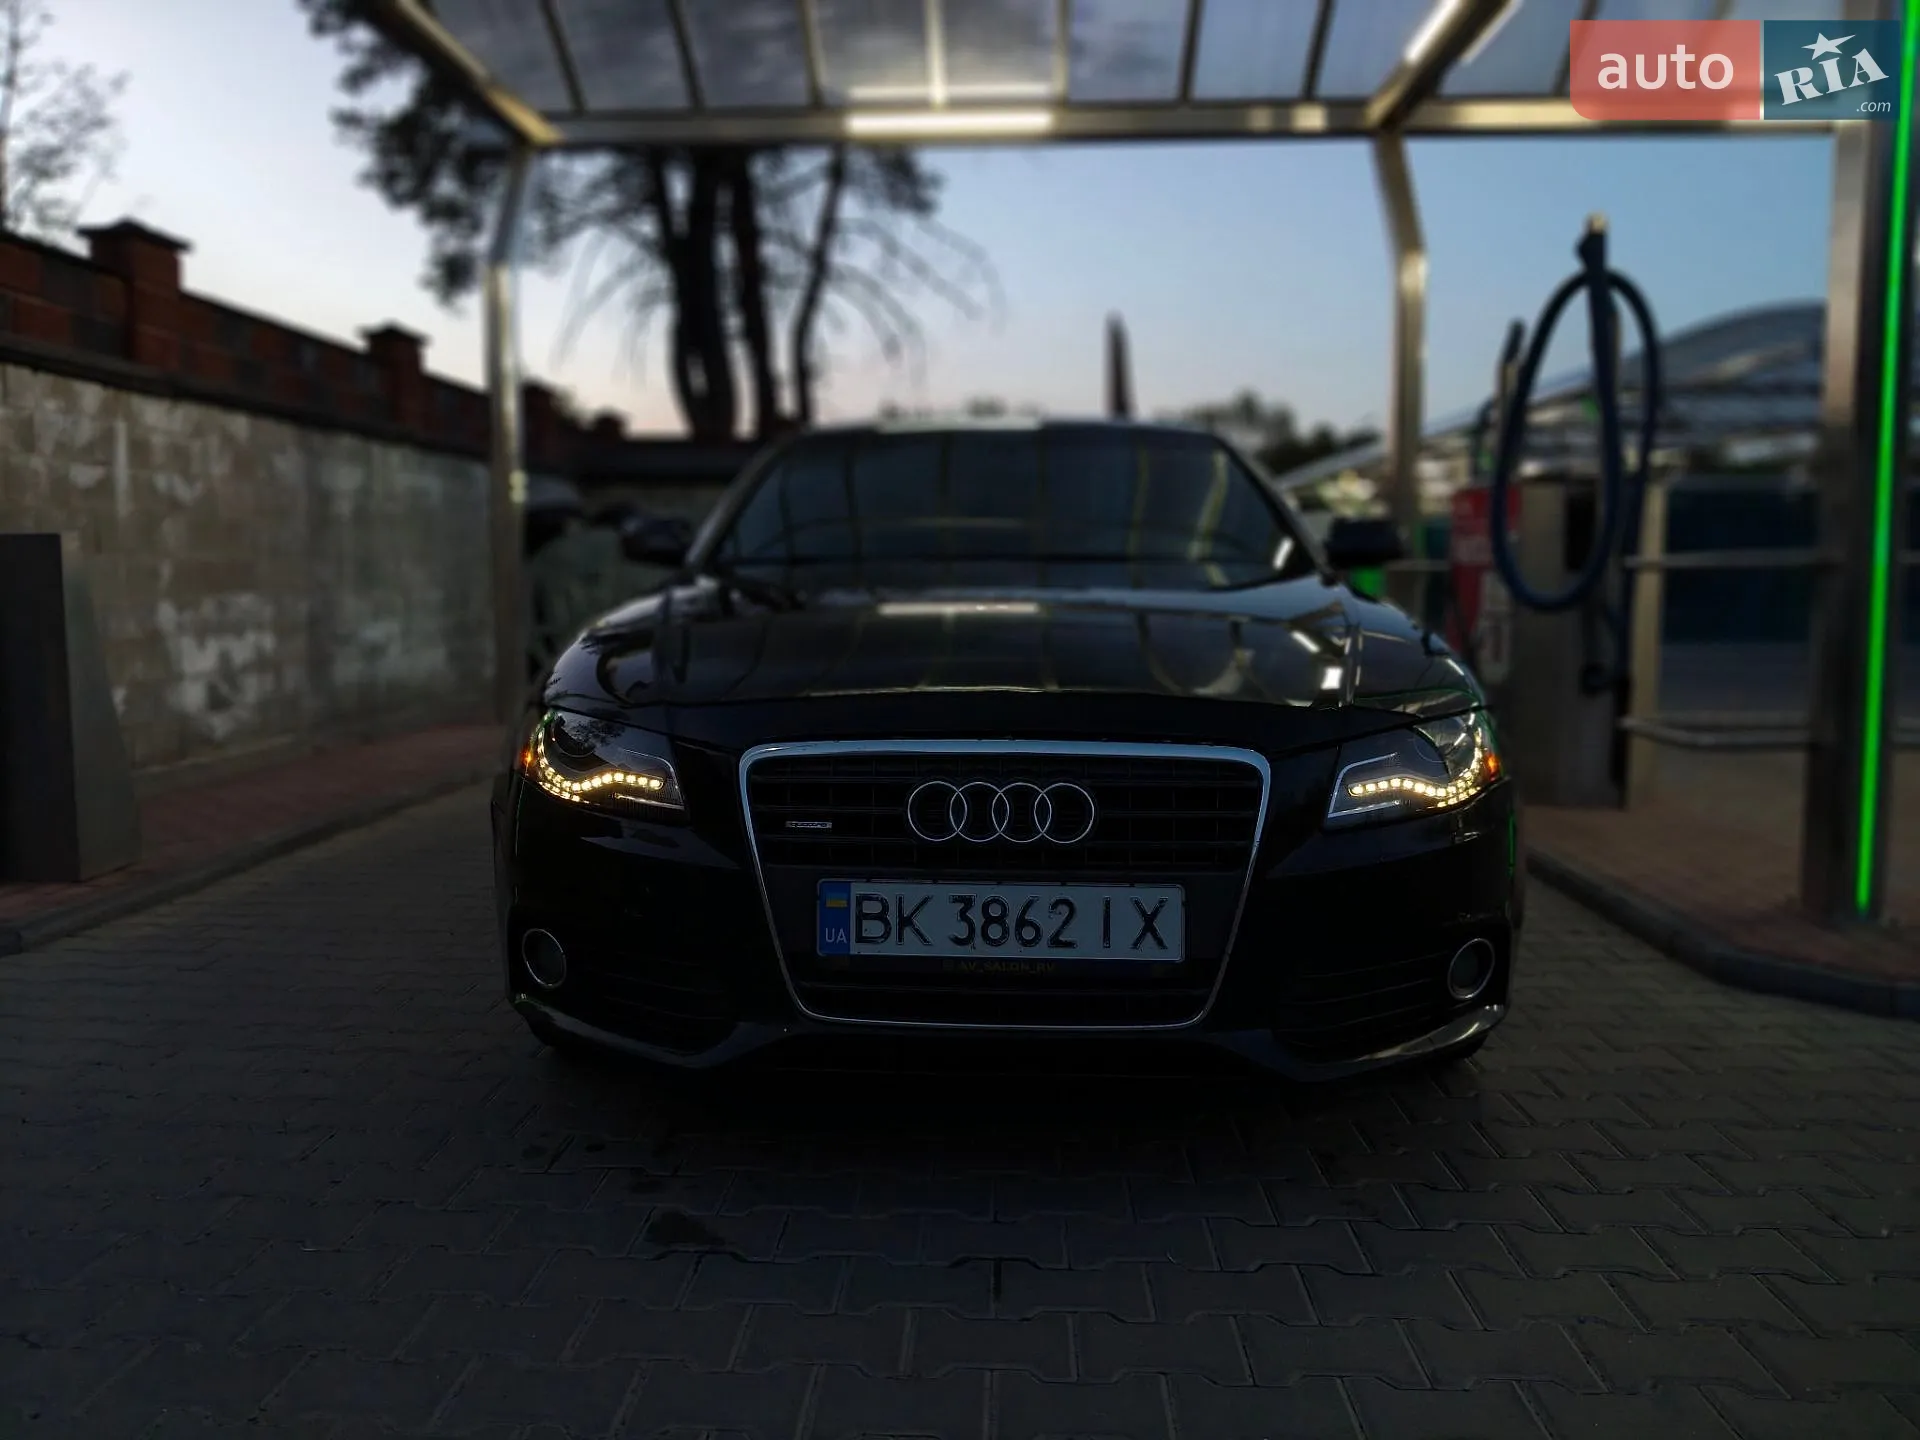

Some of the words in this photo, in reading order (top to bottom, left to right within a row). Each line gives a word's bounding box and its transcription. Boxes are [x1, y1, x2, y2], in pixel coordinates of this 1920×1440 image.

[824, 927, 848, 944] UA
[855, 892, 933, 946] BK
[947, 893, 1079, 949] 3862
[1101, 895, 1169, 950] IX
